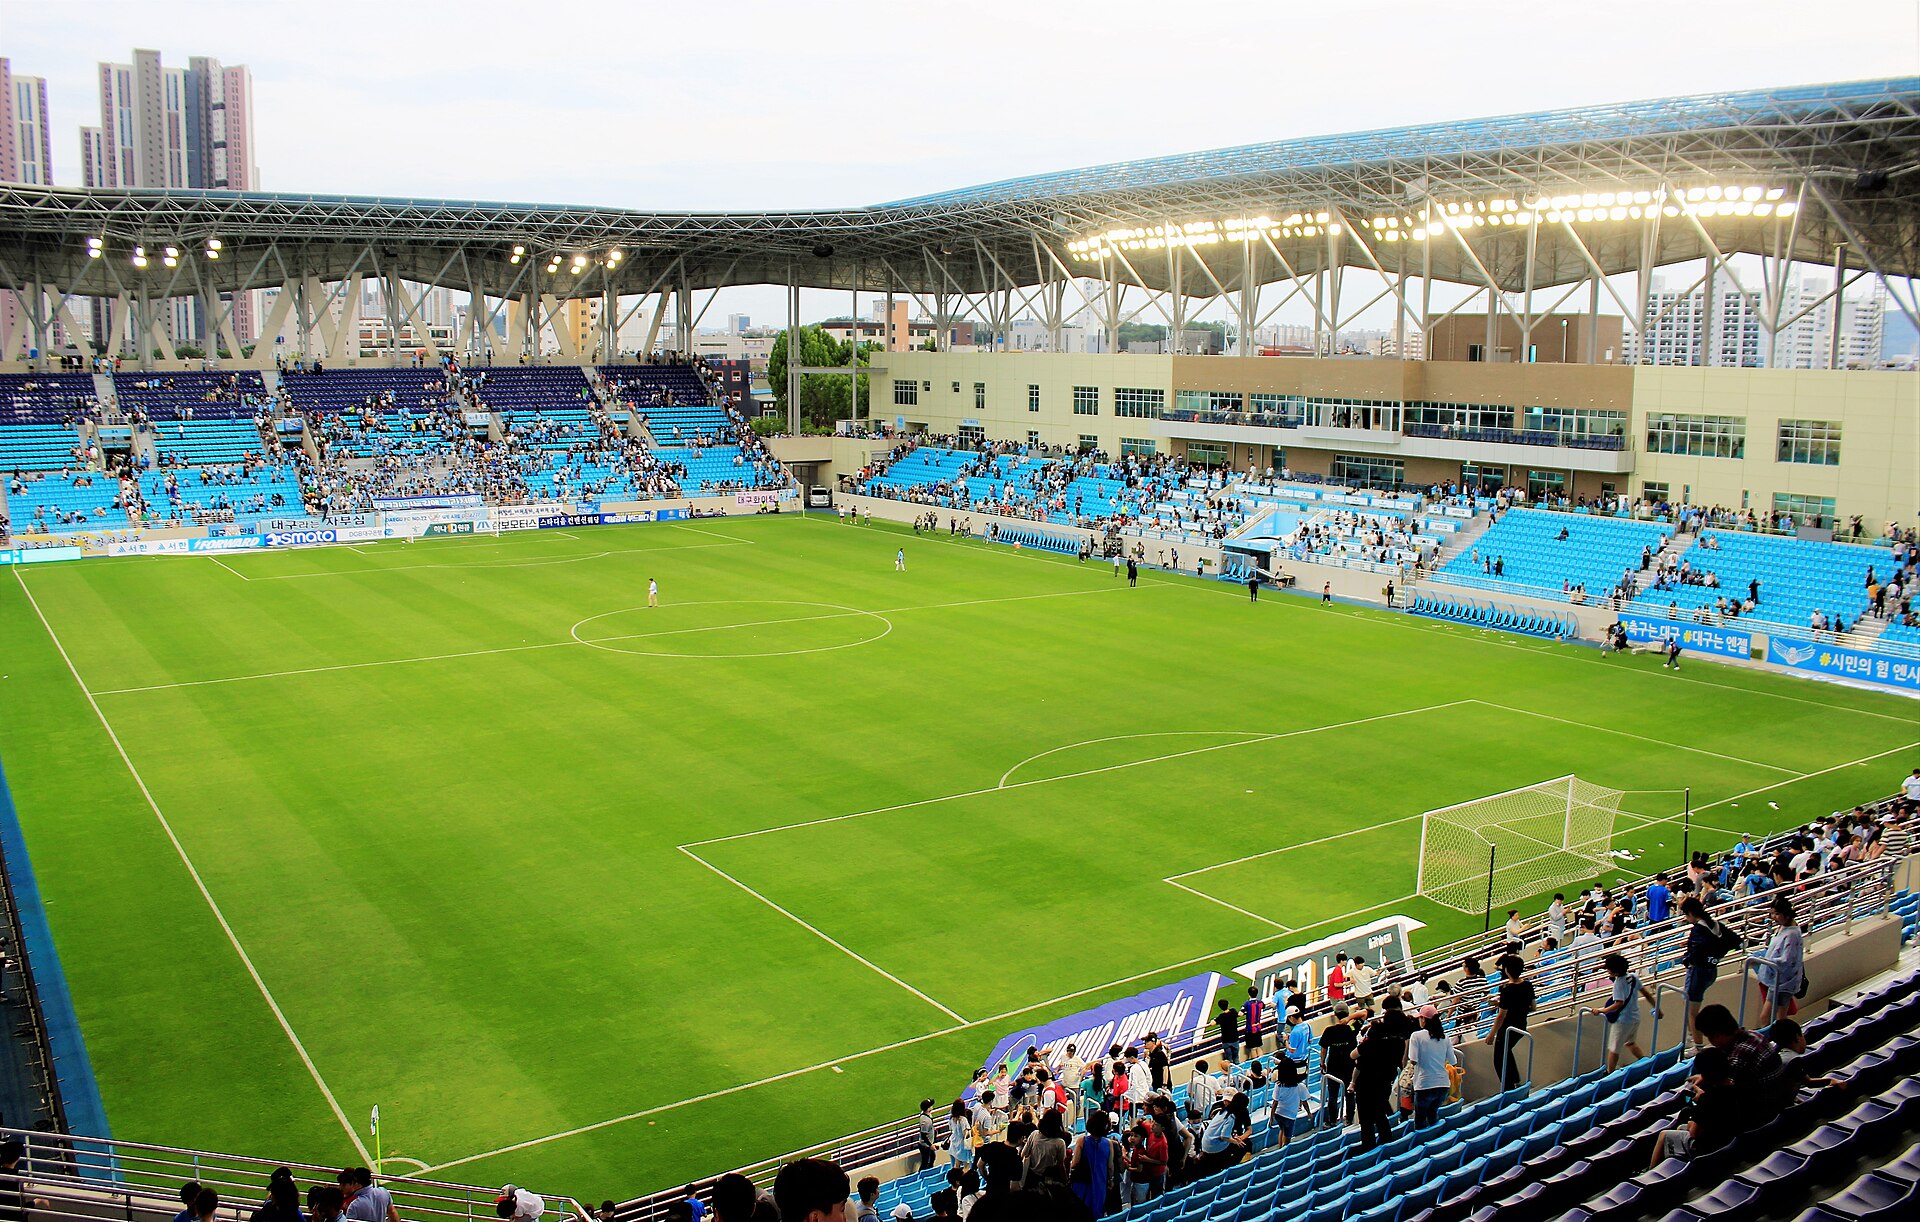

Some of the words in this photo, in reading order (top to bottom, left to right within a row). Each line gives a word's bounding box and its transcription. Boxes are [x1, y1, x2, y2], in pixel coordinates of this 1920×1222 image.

[200, 535, 261, 550] FORWARD
[1726, 635, 1748, 655] 엔젤
[1876, 660, 1889, 678] 힘
